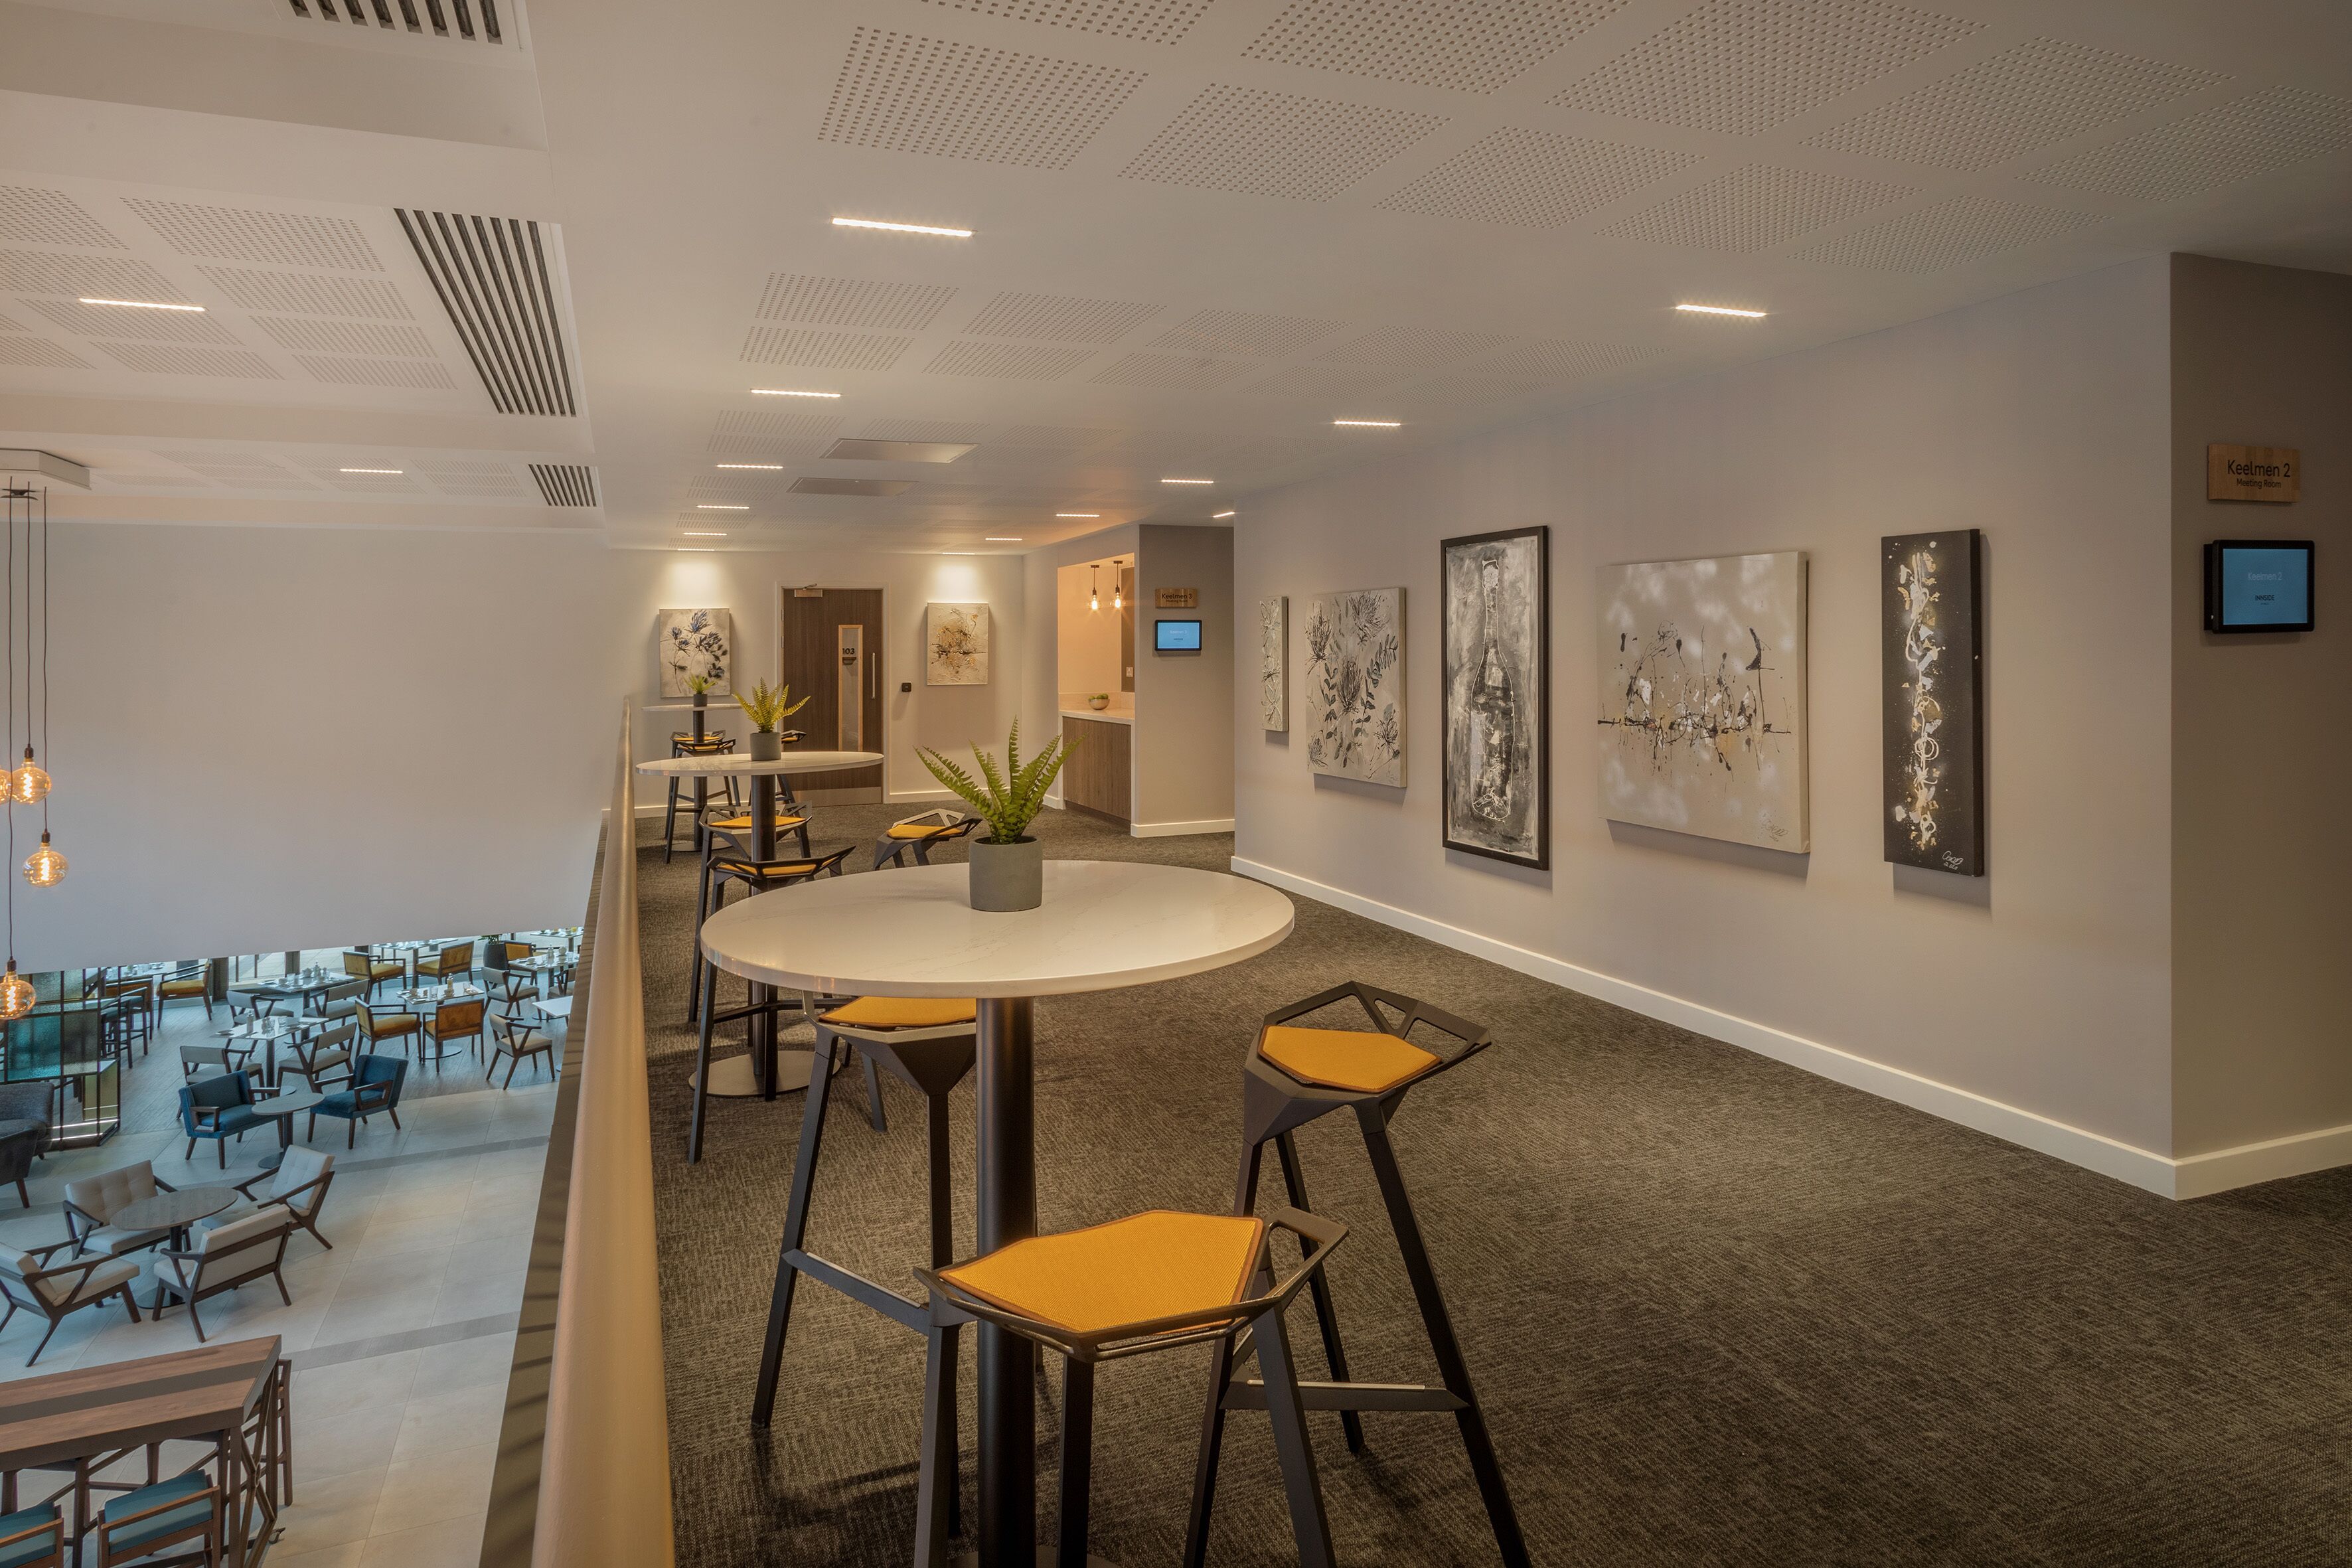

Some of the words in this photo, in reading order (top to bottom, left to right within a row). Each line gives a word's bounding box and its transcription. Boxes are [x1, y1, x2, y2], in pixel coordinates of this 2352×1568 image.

[2227, 460, 2280, 477] Keelmen
[2284, 463, 2290, 477] 2
[2236, 478, 2262, 489] Meeting
[2264, 479, 2281, 489] Room
[2248, 572, 2277, 581] Keelmen
[2278, 572, 2282, 581] 2
